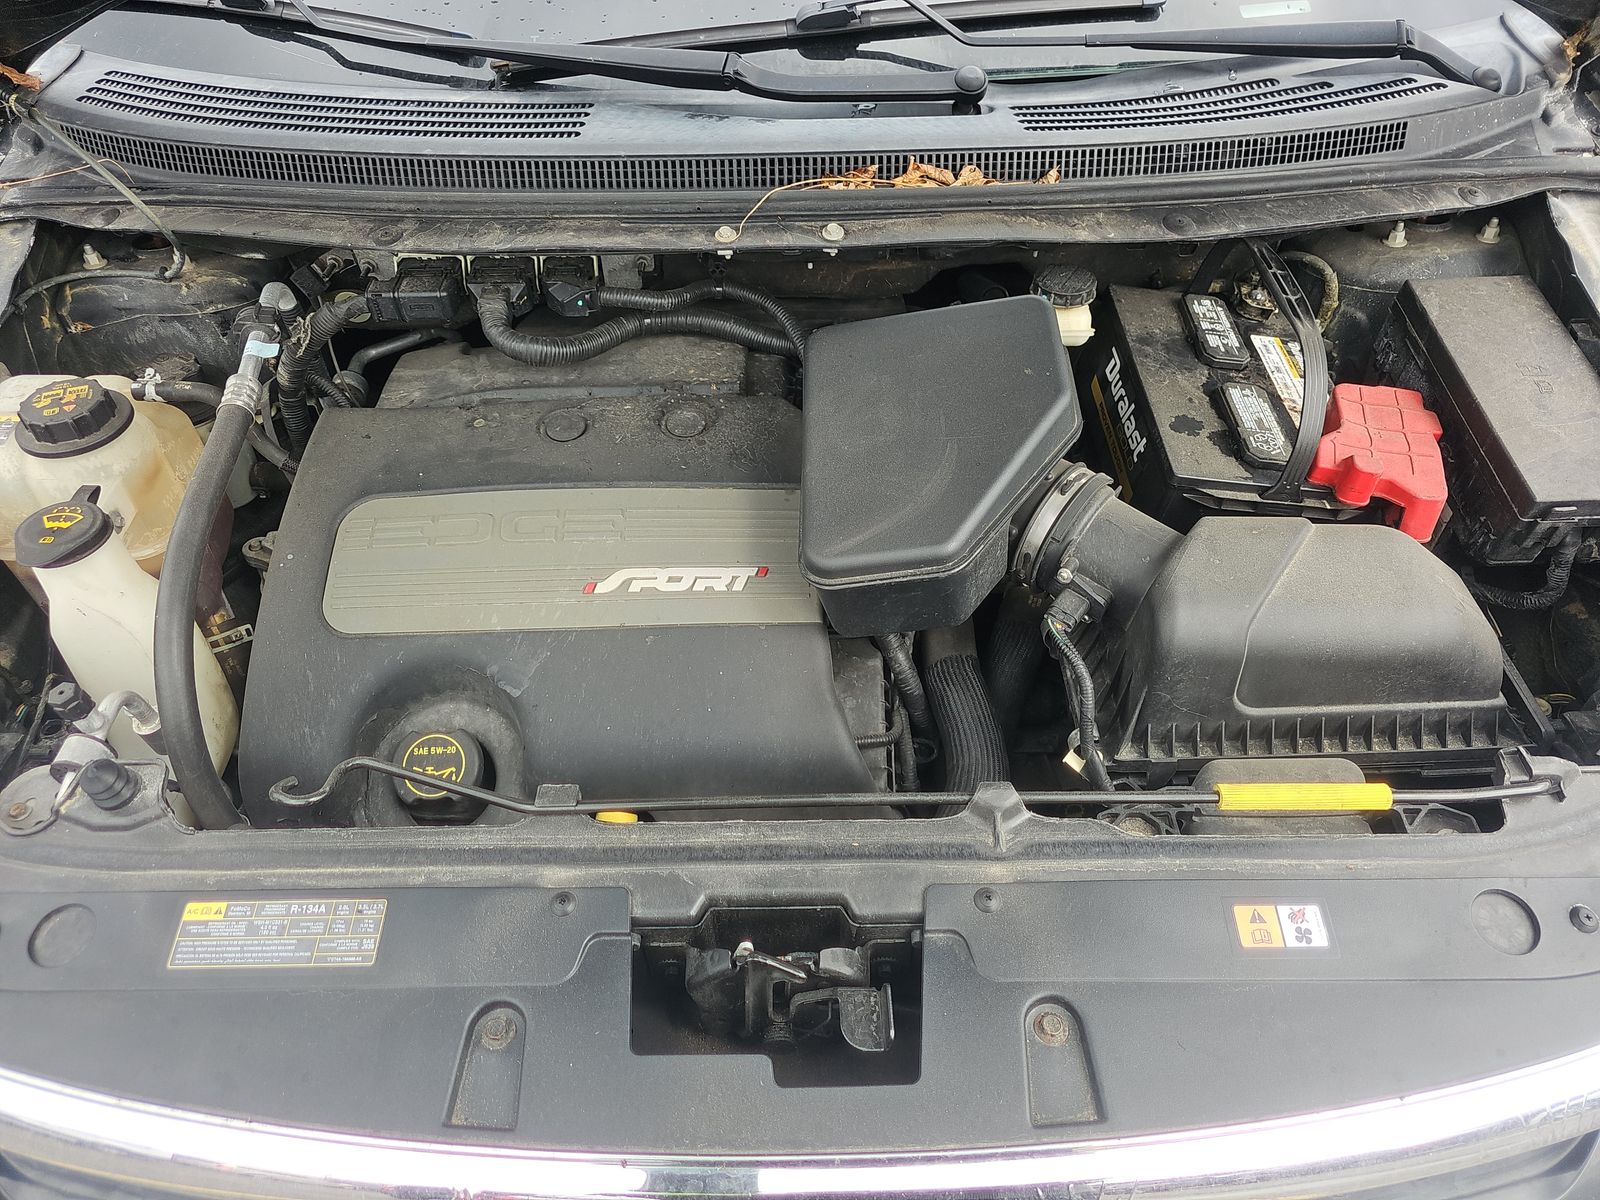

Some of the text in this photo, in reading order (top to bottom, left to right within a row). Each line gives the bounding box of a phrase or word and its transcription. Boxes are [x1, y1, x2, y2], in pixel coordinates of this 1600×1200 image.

[1104, 346, 1147, 464] Duralast
[1115, 423, 1135, 472] GOLD
[370, 507, 626, 550] EDGE
[594, 566, 760, 595] SPORT
[413, 746, 457, 755] SAE 5W-20
[290, 903, 326, 914] R-134A
